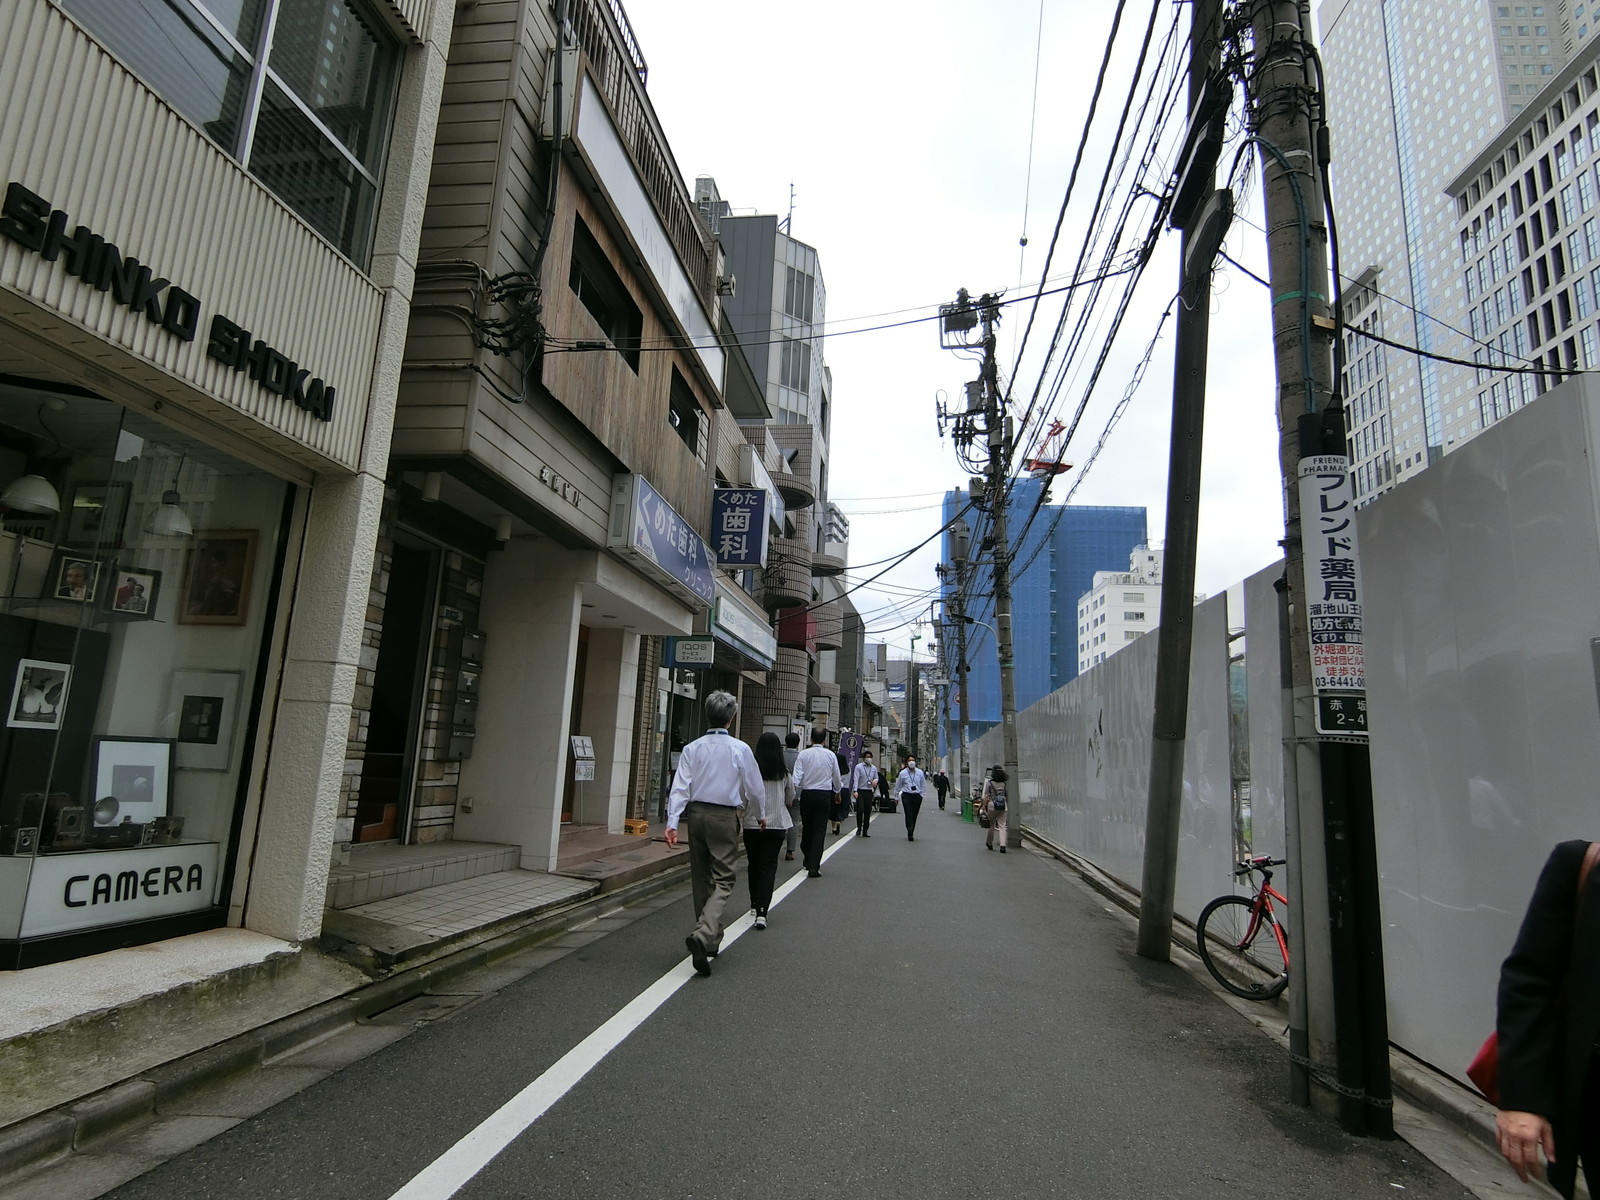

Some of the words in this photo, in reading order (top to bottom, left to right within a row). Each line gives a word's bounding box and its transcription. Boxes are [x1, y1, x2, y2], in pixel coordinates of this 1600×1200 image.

[1, 181, 201, 342] SHINKO
[206, 313, 336, 422] SHOKAI
[1313, 457, 1345, 465] FRIEND
[718, 491, 758, 506] くめた
[642, 491, 698, 566] くめた歯科
[719, 506, 752, 561] 歯科
[1316, 475, 1357, 602] フレンド薬局
[684, 565, 713, 600] クリニック
[1336, 713, 1366, 726] 2-4
[64, 864, 203, 908] CAMERA
